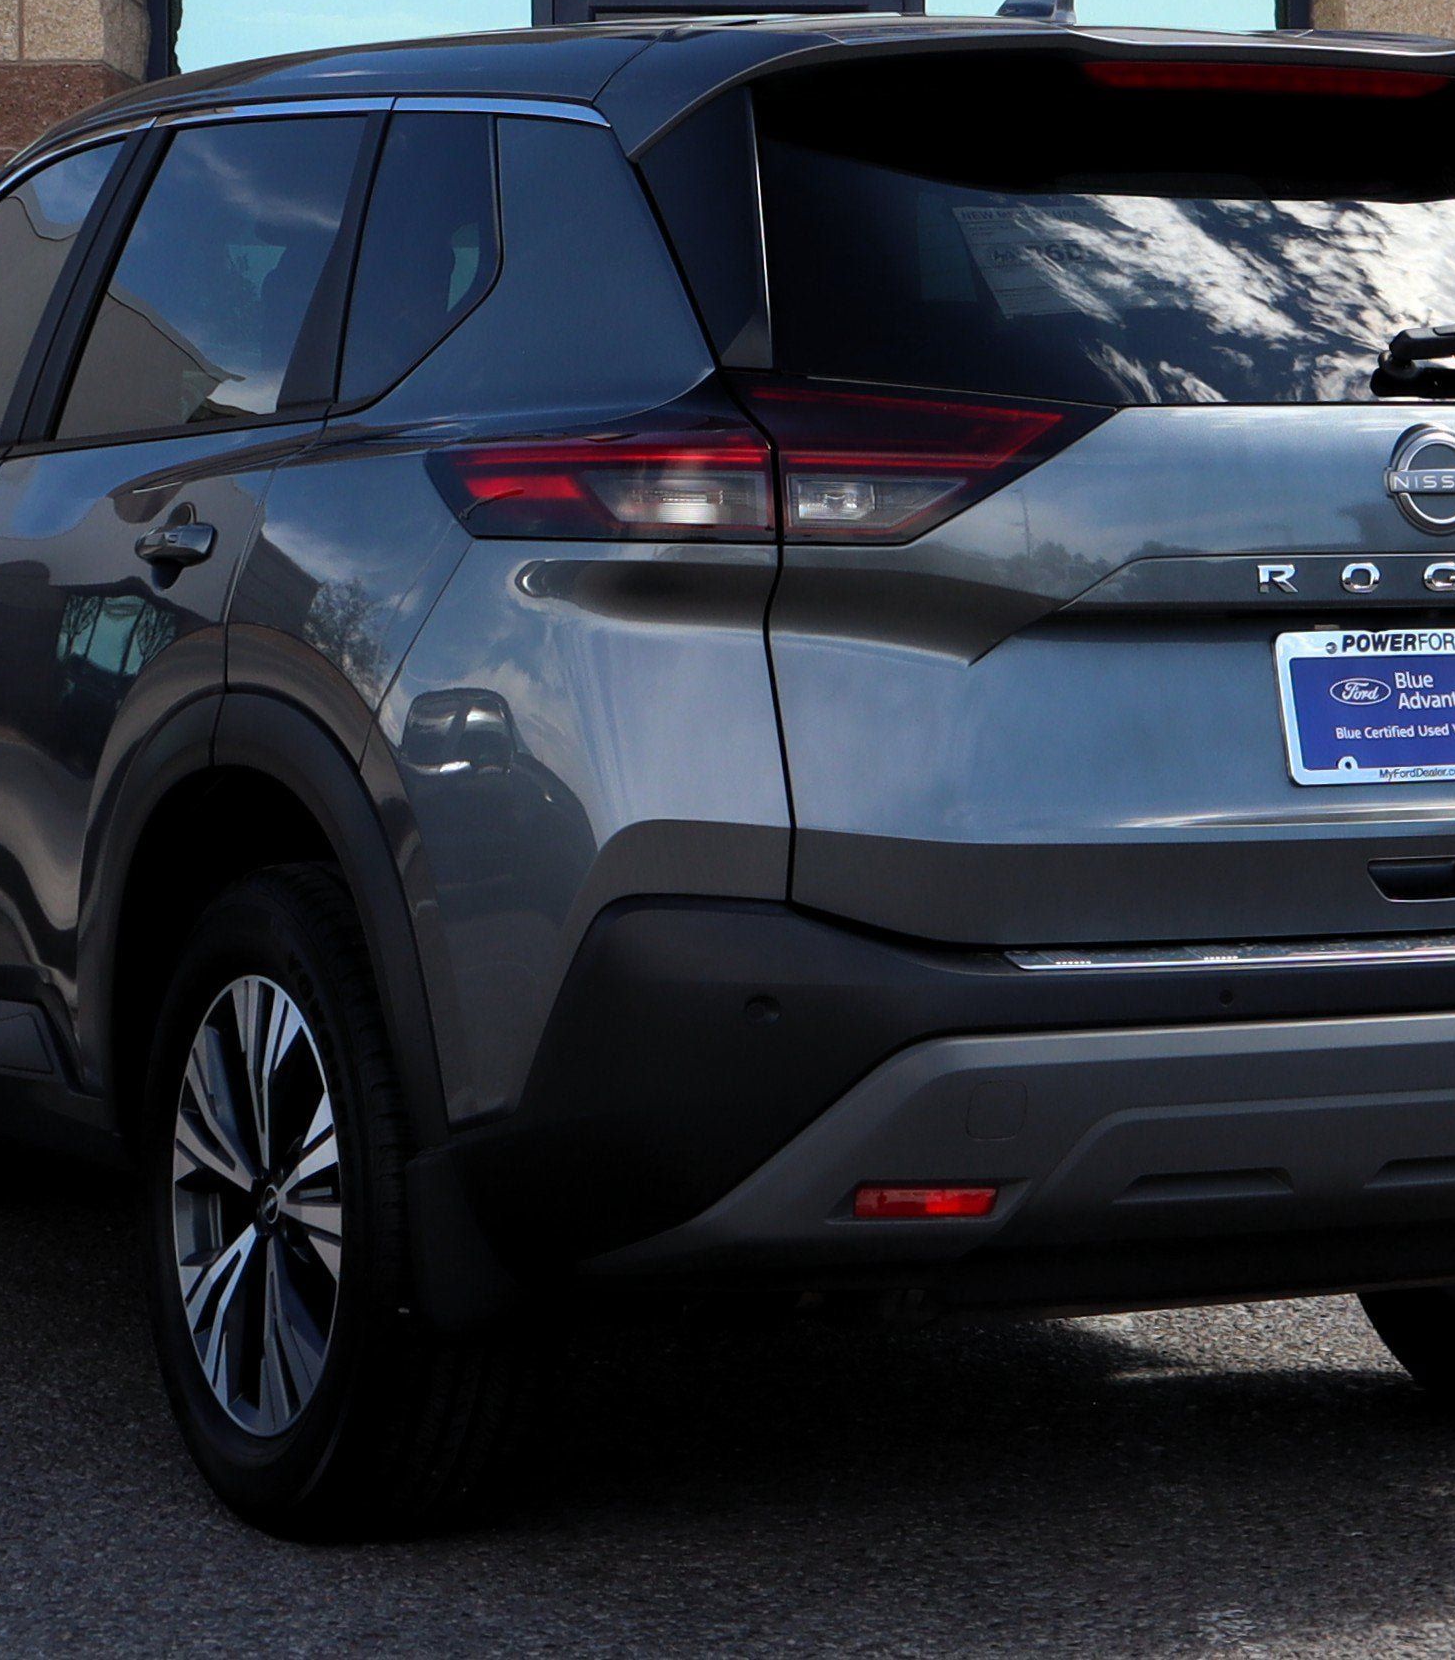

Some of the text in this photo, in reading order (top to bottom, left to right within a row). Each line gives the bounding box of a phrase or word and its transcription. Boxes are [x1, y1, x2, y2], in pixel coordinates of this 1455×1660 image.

[1394, 672, 1435, 689] Blue
[1342, 681, 1380, 701] Ford
[1336, 727, 1362, 739] Blue
[1364, 725, 1415, 739] Certified
[1418, 723, 1450, 737] Used
